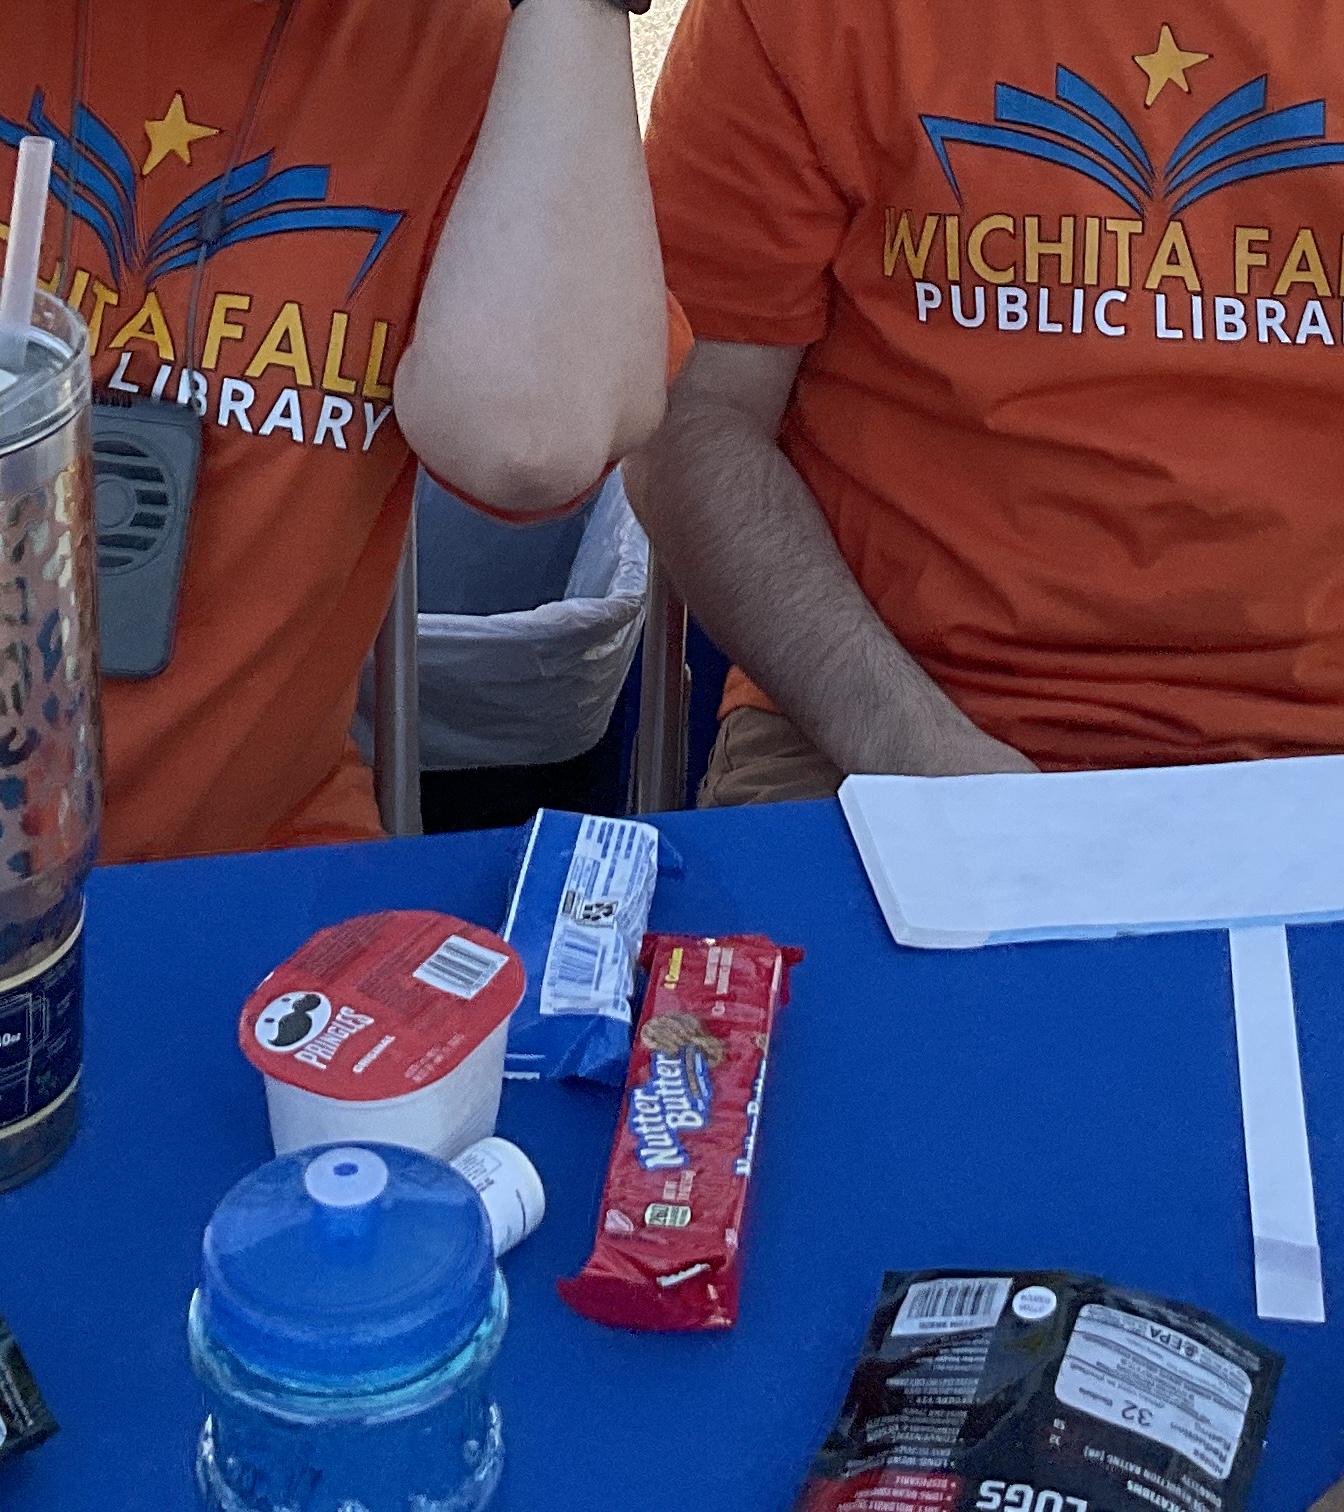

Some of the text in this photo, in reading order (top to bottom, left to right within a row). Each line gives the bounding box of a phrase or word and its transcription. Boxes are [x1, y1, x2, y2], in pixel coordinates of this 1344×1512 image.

[883, 206, 1202, 292] WICHITA
[916, 281, 1128, 338] PUBLIC
[107, 350, 393, 452] LIBRARY
[294, 1005, 375, 1070] PRINGLES
[656, 1053, 704, 1129] Butter
[634, 1088, 685, 1169] Nutter
[1149, 1325, 1182, 1350] EPA
[1121, 1399, 1153, 1427] 32
